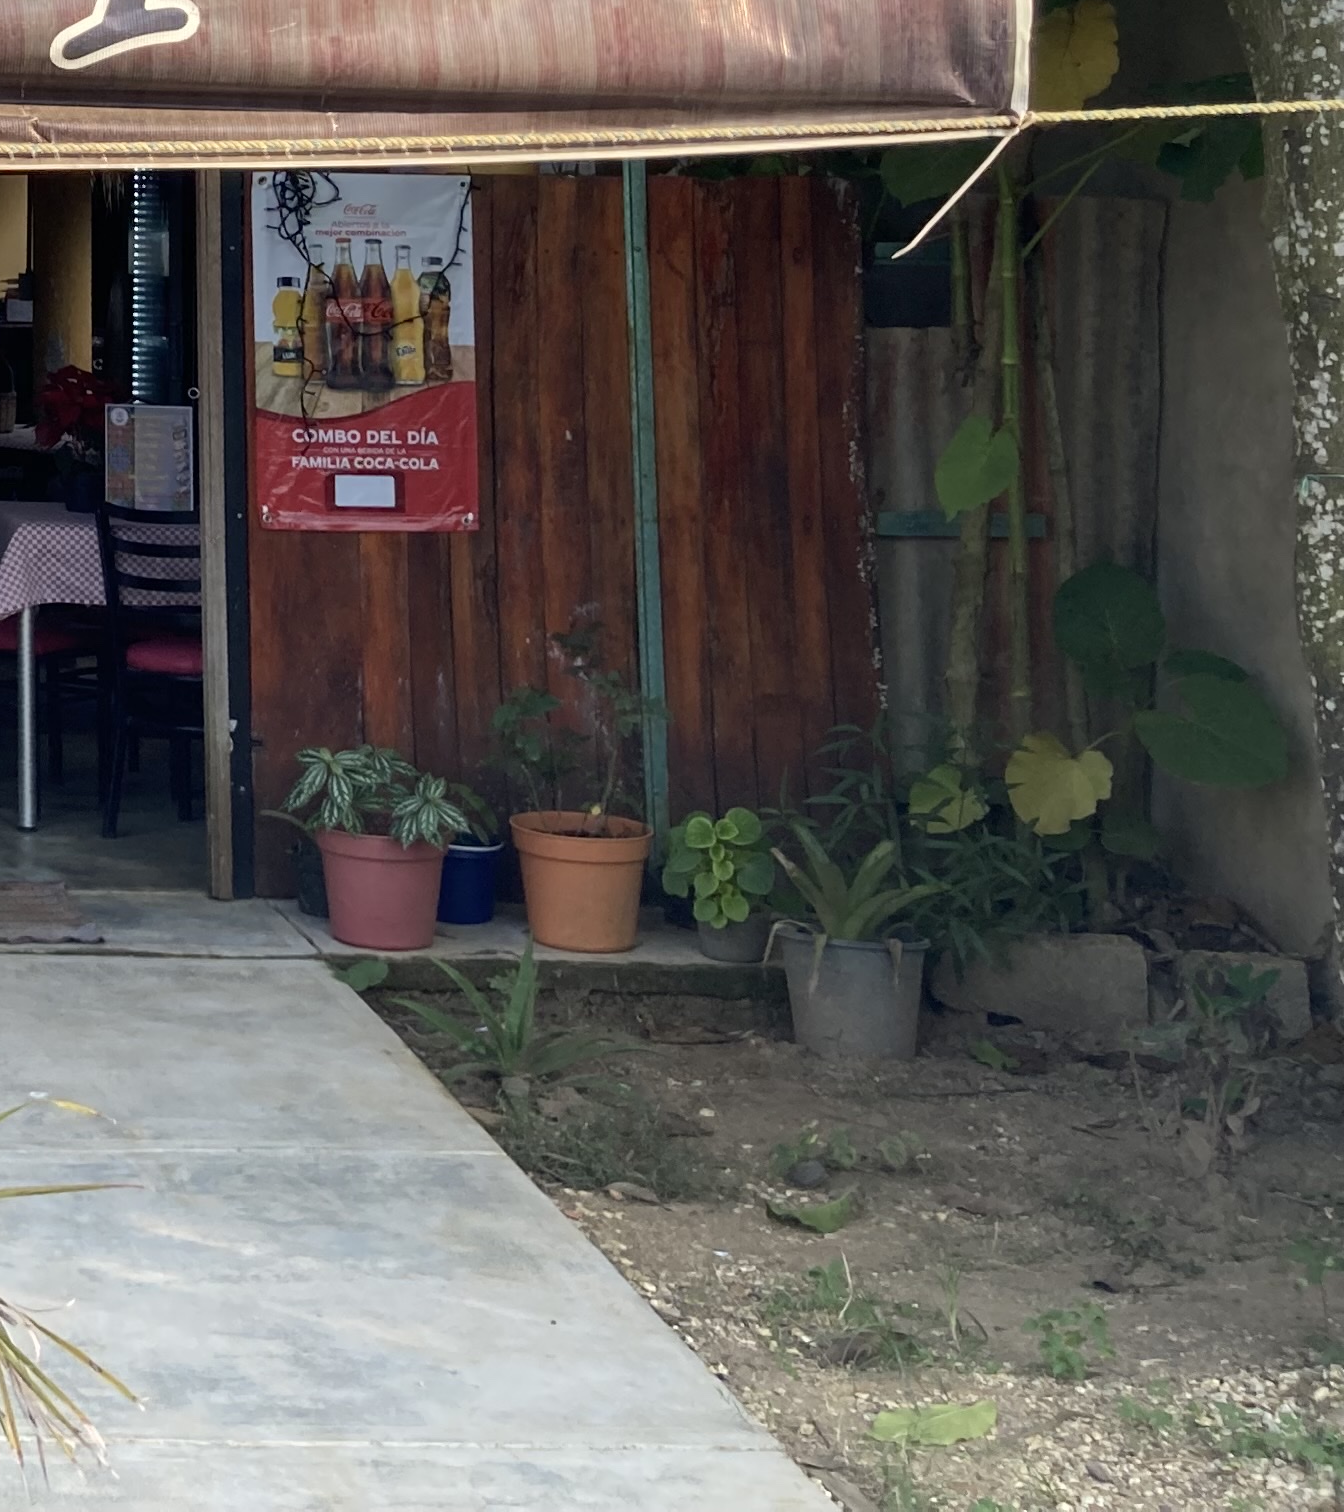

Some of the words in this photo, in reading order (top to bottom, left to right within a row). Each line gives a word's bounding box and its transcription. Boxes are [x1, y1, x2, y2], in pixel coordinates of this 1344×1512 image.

[315, 229, 343, 237] mejor
[291, 428, 361, 444] COMBO
[366, 430, 403, 445] DEL
[407, 427, 439, 445] DÍA
[291, 456, 351, 470] FAMILIA
[354, 457, 439, 471] COCA-COLA
